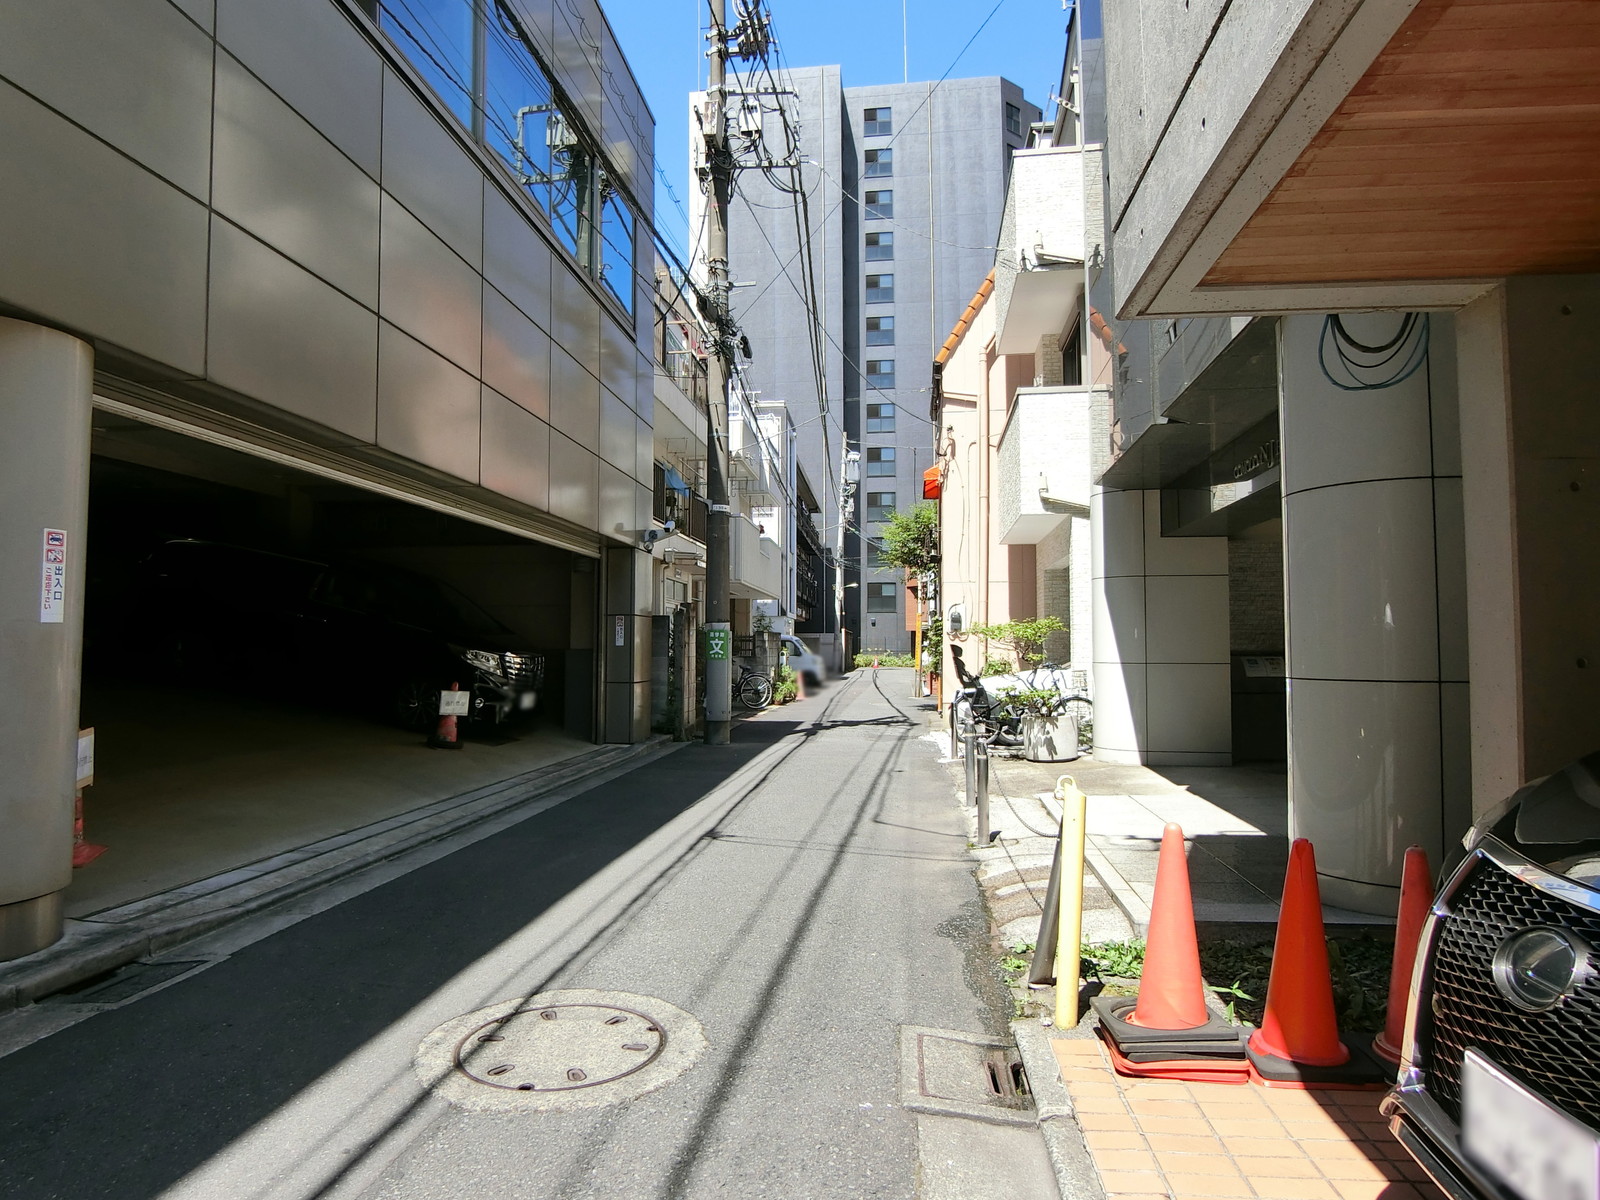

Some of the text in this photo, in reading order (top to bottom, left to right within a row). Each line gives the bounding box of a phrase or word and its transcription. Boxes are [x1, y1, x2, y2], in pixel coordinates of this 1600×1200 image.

[54, 566, 62, 600] 出入口
[709, 638, 724, 654] 文
